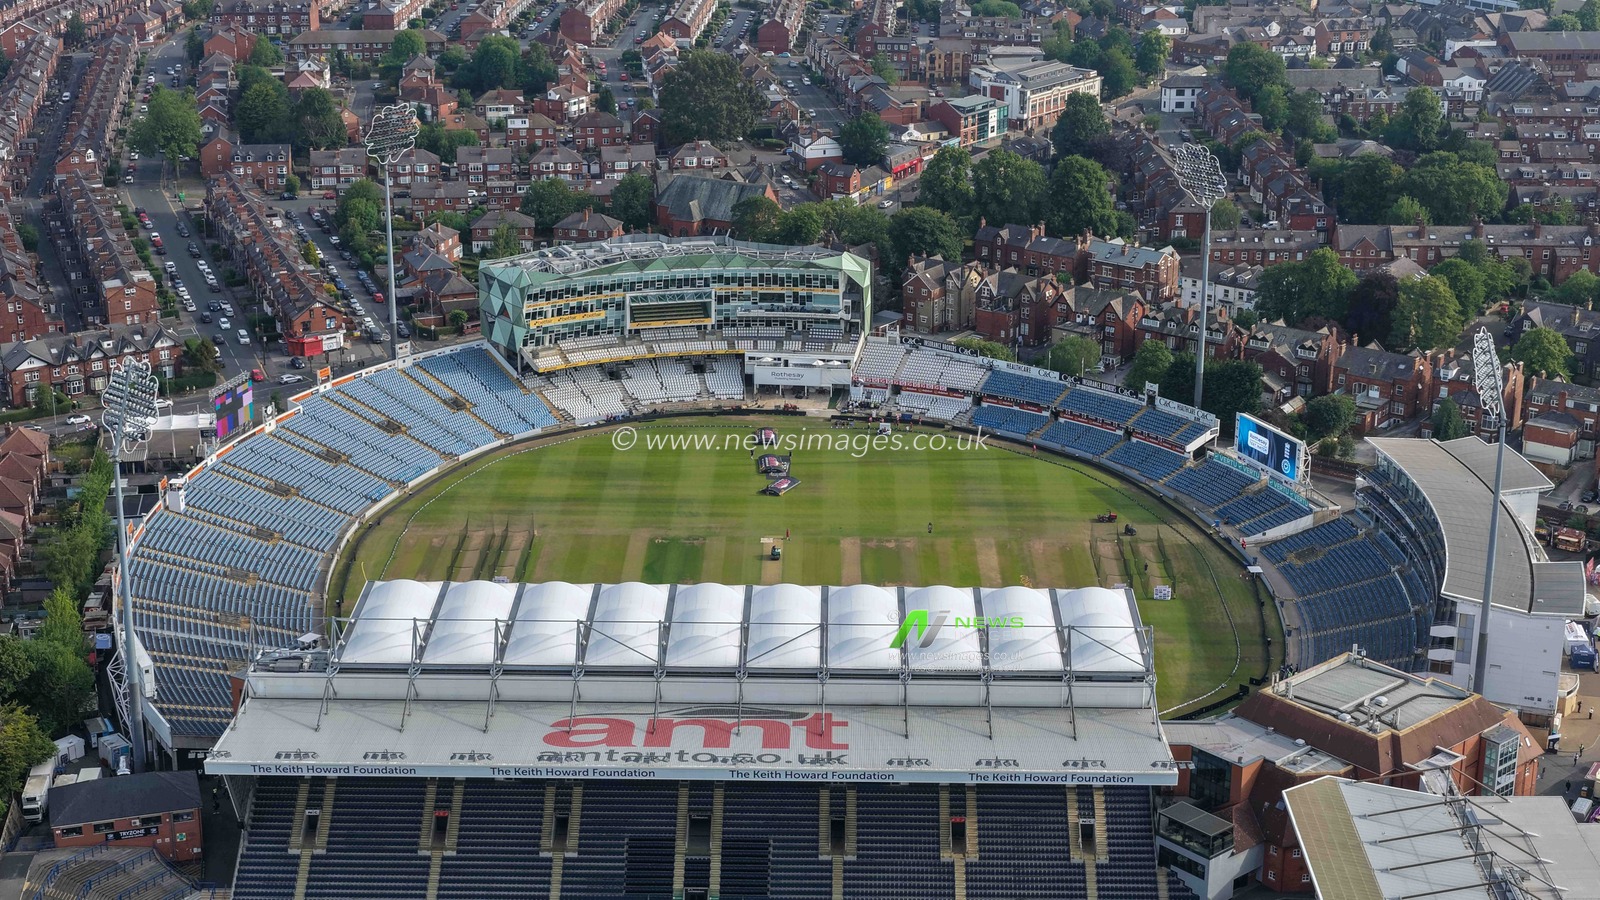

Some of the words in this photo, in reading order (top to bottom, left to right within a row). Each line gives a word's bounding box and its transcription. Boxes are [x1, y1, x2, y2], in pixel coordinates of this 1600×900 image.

[1220, 454, 1238, 467] VERTU
[1243, 465, 1260, 478] VERTU
[1273, 480, 1290, 494] VERTU
[1293, 493, 1309, 507] VERTU
[542, 713, 849, 750] amt
[251, 765, 272, 773] The
[275, 765, 304, 773] Keith
[306, 765, 350, 774] Howard
[353, 766, 417, 775] Foundation
[490, 767, 511, 776] The
[514, 767, 542, 776] Keith
[546, 768, 589, 777] Howard
[592, 768, 656, 778] Foundation
[729, 770, 750, 779] The
[753, 770, 782, 779] Keith
[785, 771, 828, 780] Howard
[831, 771, 894, 780] Foundation
[968, 772, 989, 782] The
[992, 773, 1021, 782] Keith
[1024, 773, 1067, 782] Howard
[1071, 774, 1134, 783] Foundation
